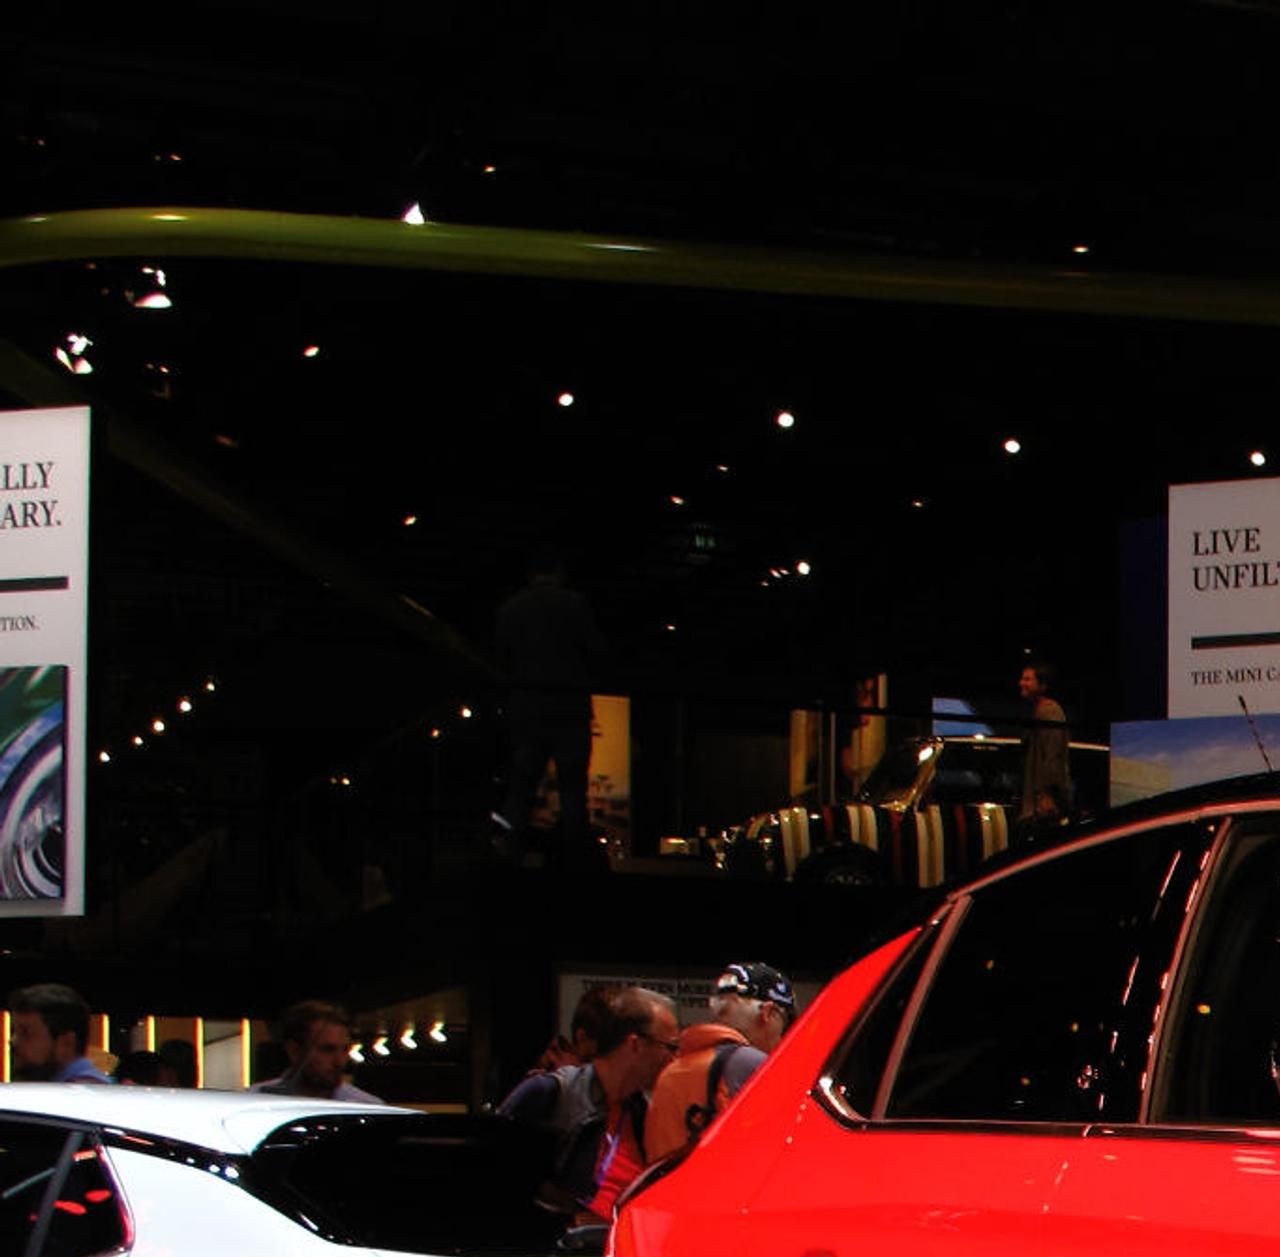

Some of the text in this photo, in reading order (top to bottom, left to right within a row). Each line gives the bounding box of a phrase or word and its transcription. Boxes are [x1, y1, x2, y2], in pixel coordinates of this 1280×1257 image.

[0, 462, 54, 491] LLY
[1193, 527, 1261, 556] LIVE
[1191, 669, 1223, 686] THE
[1225, 666, 1264, 684] MINI
